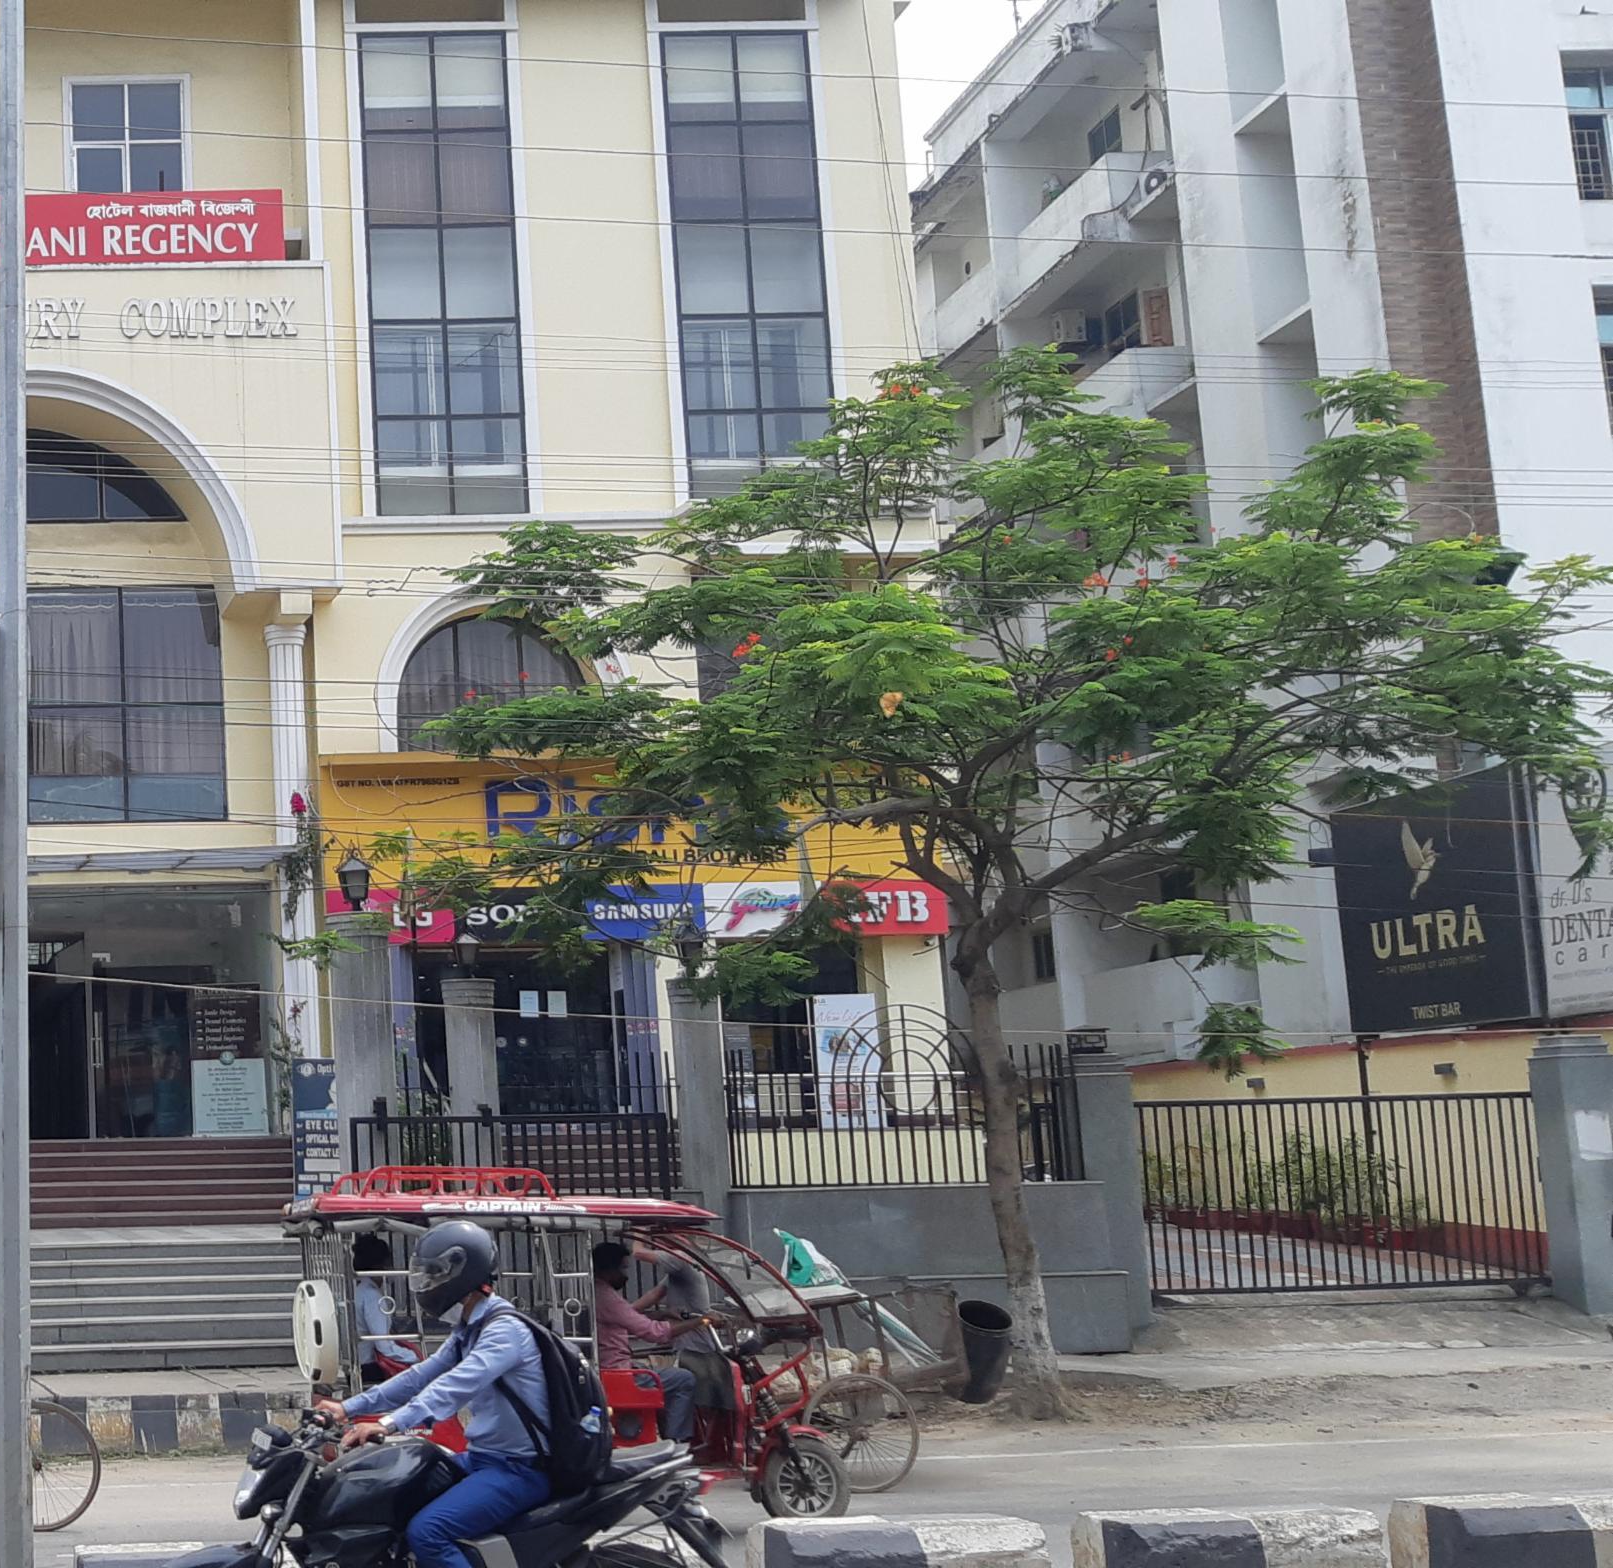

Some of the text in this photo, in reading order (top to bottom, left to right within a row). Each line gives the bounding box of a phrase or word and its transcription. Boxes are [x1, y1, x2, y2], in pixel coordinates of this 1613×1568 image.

[102, 222, 259, 257] REGENCY
[119, 296, 298, 339] COMPLEX
[466, 904, 548, 927] SON
[593, 902, 694, 920] SAMSUNG
[1370, 904, 1487, 960] ULTRA
[1411, 1002, 1461, 1020] TWIST BAR
[305, 1119, 322, 1130] EYE
[305, 1134, 329, 1144] OPTICAL
[305, 1148, 331, 1158] CONTACT
[464, 1201, 543, 1213] CAPTAIN
